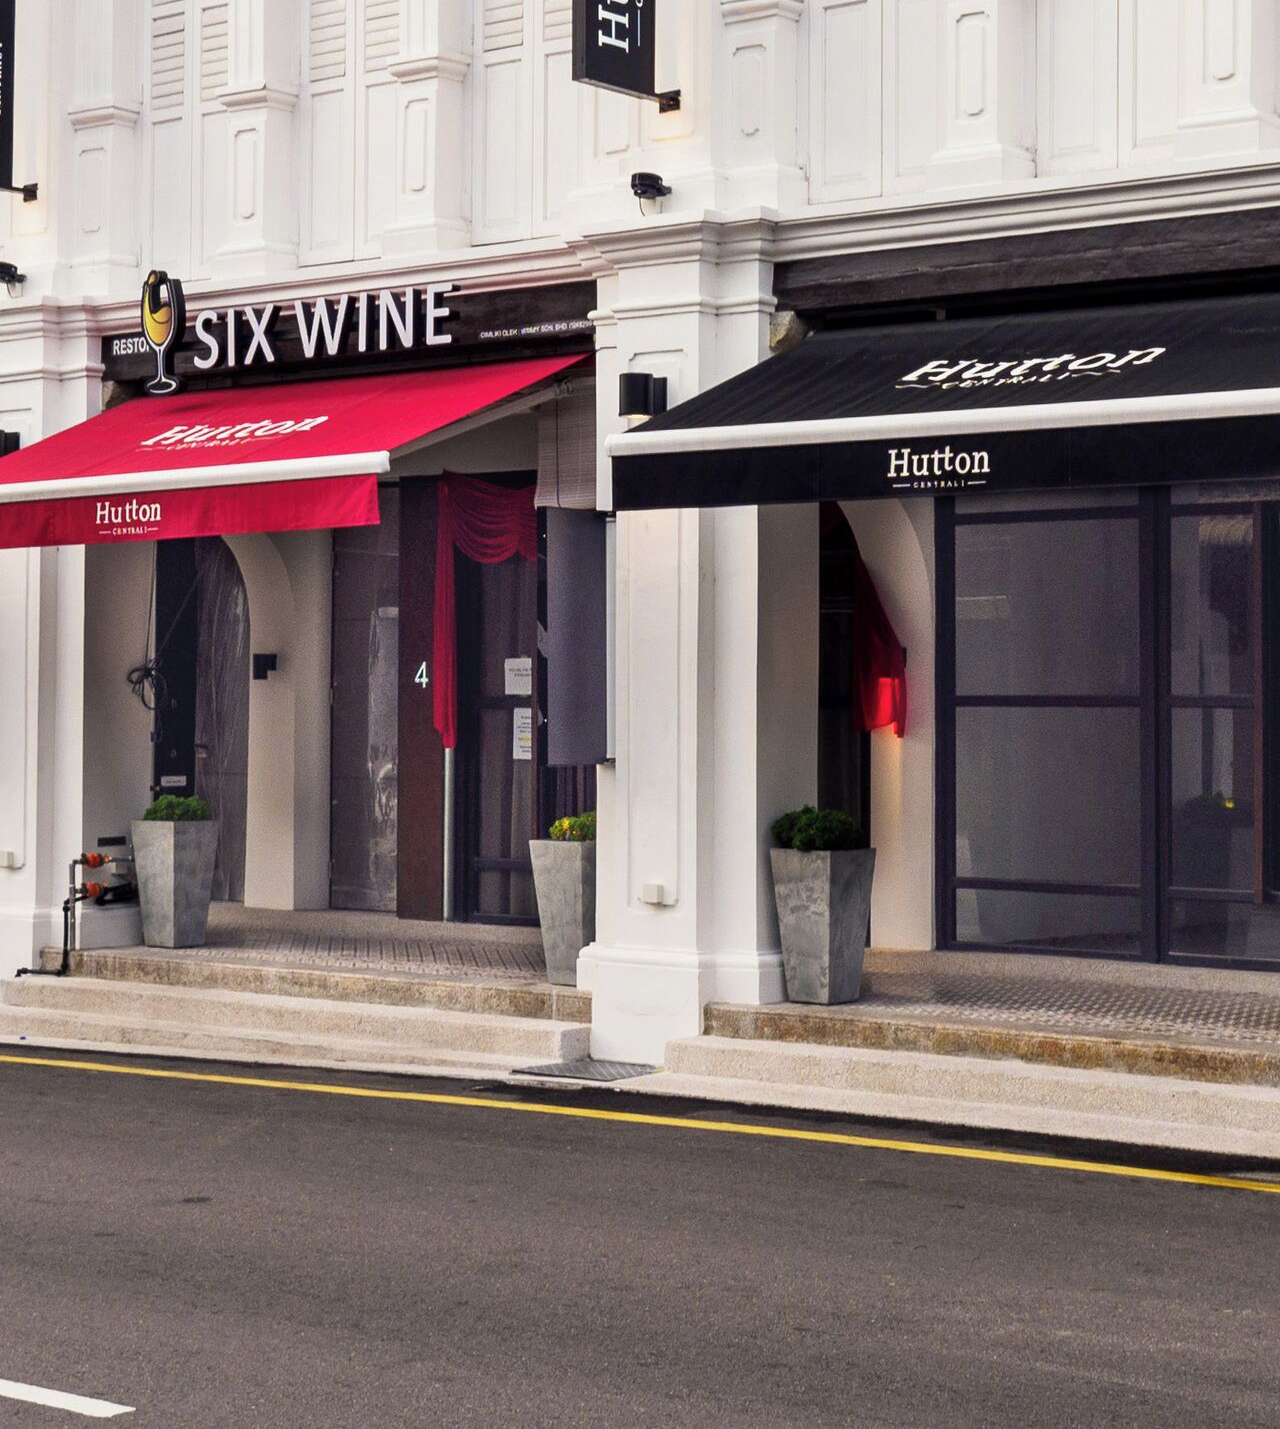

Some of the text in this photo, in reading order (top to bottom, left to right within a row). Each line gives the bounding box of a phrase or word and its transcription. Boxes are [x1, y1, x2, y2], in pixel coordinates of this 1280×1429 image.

[194, 283, 453, 369] SIX WINE
[901, 347, 1166, 381] Hutton
[140, 415, 328, 446] Hutton
[887, 445, 990, 478] Hutton
[913, 480, 959, 489] CENTRAL
[95, 498, 161, 524] Hutton
[414, 661, 429, 688] 4
